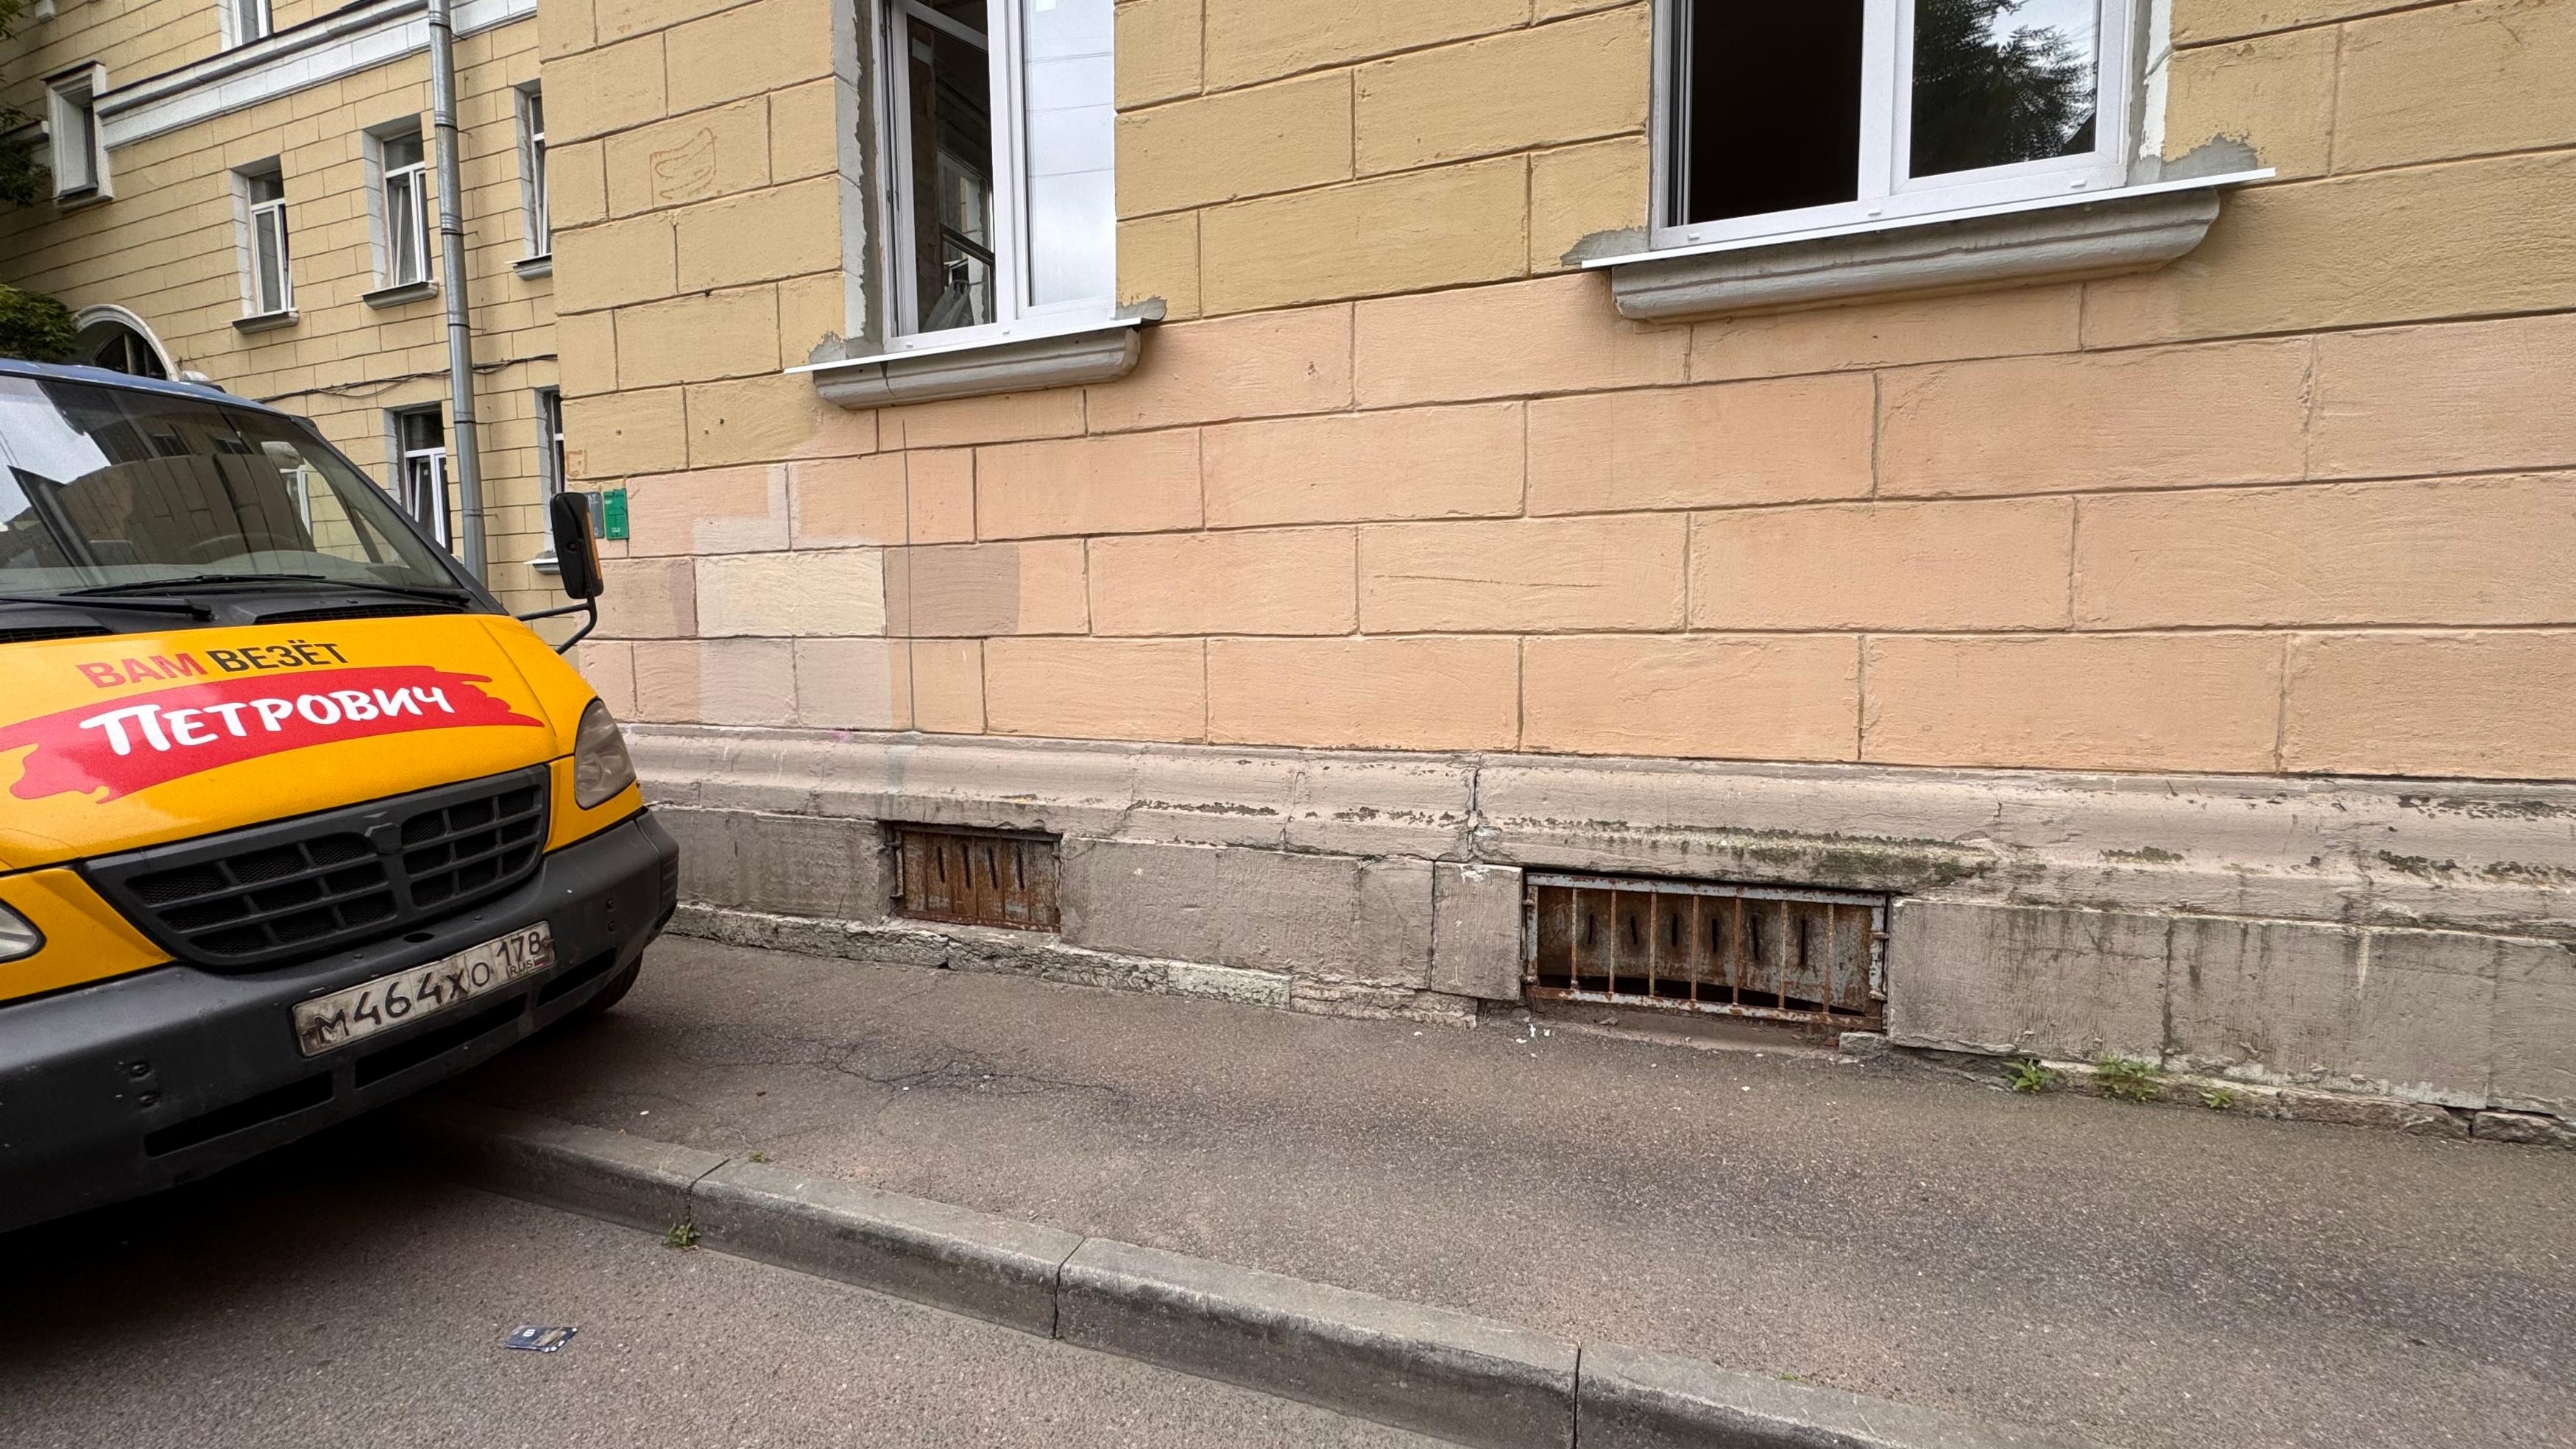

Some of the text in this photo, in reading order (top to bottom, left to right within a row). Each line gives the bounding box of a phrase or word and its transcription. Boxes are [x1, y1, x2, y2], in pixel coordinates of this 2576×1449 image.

[75, 640, 349, 688] ВАМ ВЕЗЁТ
[497, 930, 541, 966] 178
[510, 960, 533, 976] RUS
